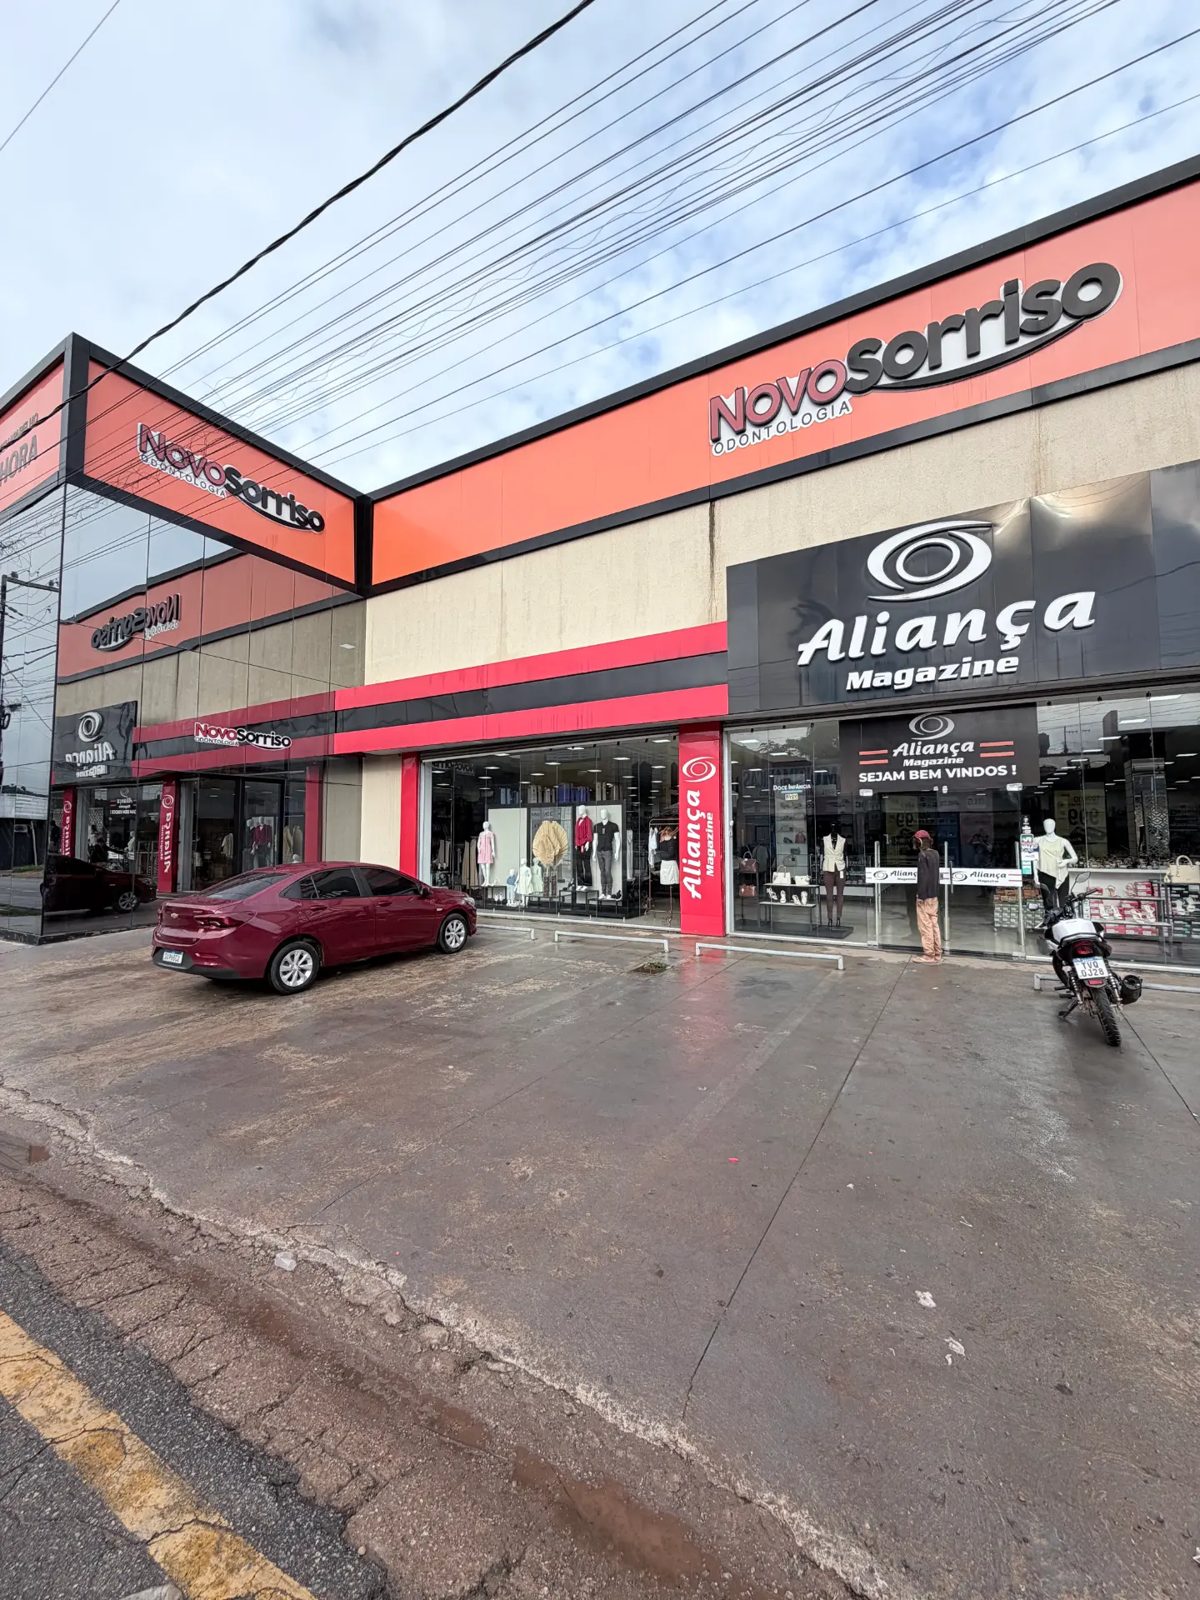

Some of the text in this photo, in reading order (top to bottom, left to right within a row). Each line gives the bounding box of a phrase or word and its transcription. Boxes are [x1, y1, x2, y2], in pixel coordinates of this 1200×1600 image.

[712, 399, 852, 456] ODONTOLOGIA
[141, 455, 227, 498] ODONTOLOGIA
[797, 589, 1096, 667] Aliança
[846, 654, 1020, 692] Magazine
[892, 740, 975, 758] Aliança
[903, 756, 965, 768] Magazine
[859, 770, 906, 783] SEJAM
[909, 769, 942, 780] BEM
[945, 765, 1008, 778] VINDOS
[682, 789, 706, 900] Aliança
[705, 812, 716, 877] Magazine
[890, 869, 917, 878] Alianç
[970, 870, 1007, 879] Aliança
